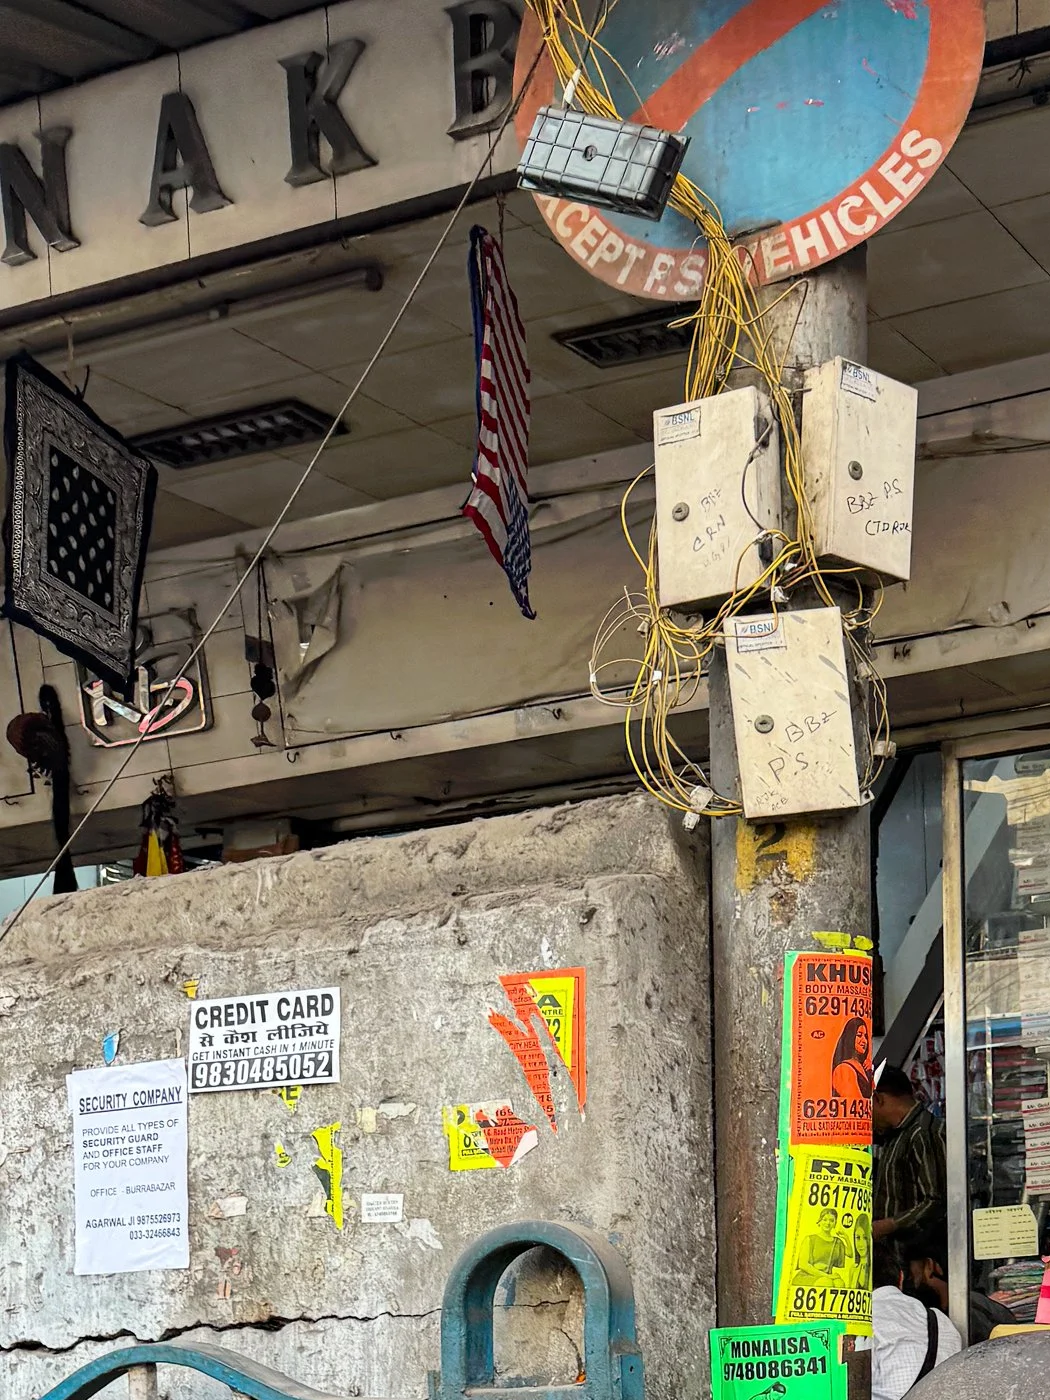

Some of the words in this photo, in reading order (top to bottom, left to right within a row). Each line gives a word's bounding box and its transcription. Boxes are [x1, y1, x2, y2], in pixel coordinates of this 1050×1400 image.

[853, 367, 872, 384] BSNL
[671, 412, 695, 426] BSNL
[805, 984, 833, 994] BODY
[195, 1000, 269, 1030] CREDIT
[276, 993, 334, 1021] CARD
[199, 1032, 215, 1047] से
[265, 1021, 329, 1041] लीजिये
[192, 1050, 209, 1061] GET
[212, 1047, 251, 1060] INSTANT
[253, 1044, 277, 1056] CASH
[279, 1043, 289, 1053] IN
[299, 1039, 335, 1051] MINUTE
[195, 1052, 330, 1088] 9830485052
[79, 1093, 128, 1112] SECURITY
[132, 1086, 182, 1106] COMPANY
[82, 1125, 119, 1137] PROVIDE
[121, 1123, 136, 1133] ALL
[137, 1120, 165, 1131] TYPES
[166, 1118, 180, 1128] OF
[82, 1136, 126, 1149] SECURITY
[128, 1132, 159, 1144] GUARD
[83, 1150, 100, 1160] AND
[102, 1147, 134, 1158] OFFICE
[136, 1143, 163, 1154] STAFF
[83, 1162, 101, 1171] FOR
[102, 1159, 127, 1170] YOUR
[128, 1155, 170, 1167] COMPANY
[809, 1173, 835, 1182] BODY
[90, 1187, 118, 1198] OFFICE
[126, 1181, 176, 1195] BURRABAZAR
[85, 1217, 127, 1229] AGARWAL
[128, 1215, 136, 1226] JI
[731, 1336, 810, 1359] MONALISA
[723, 1356, 827, 1381] 9748086341
